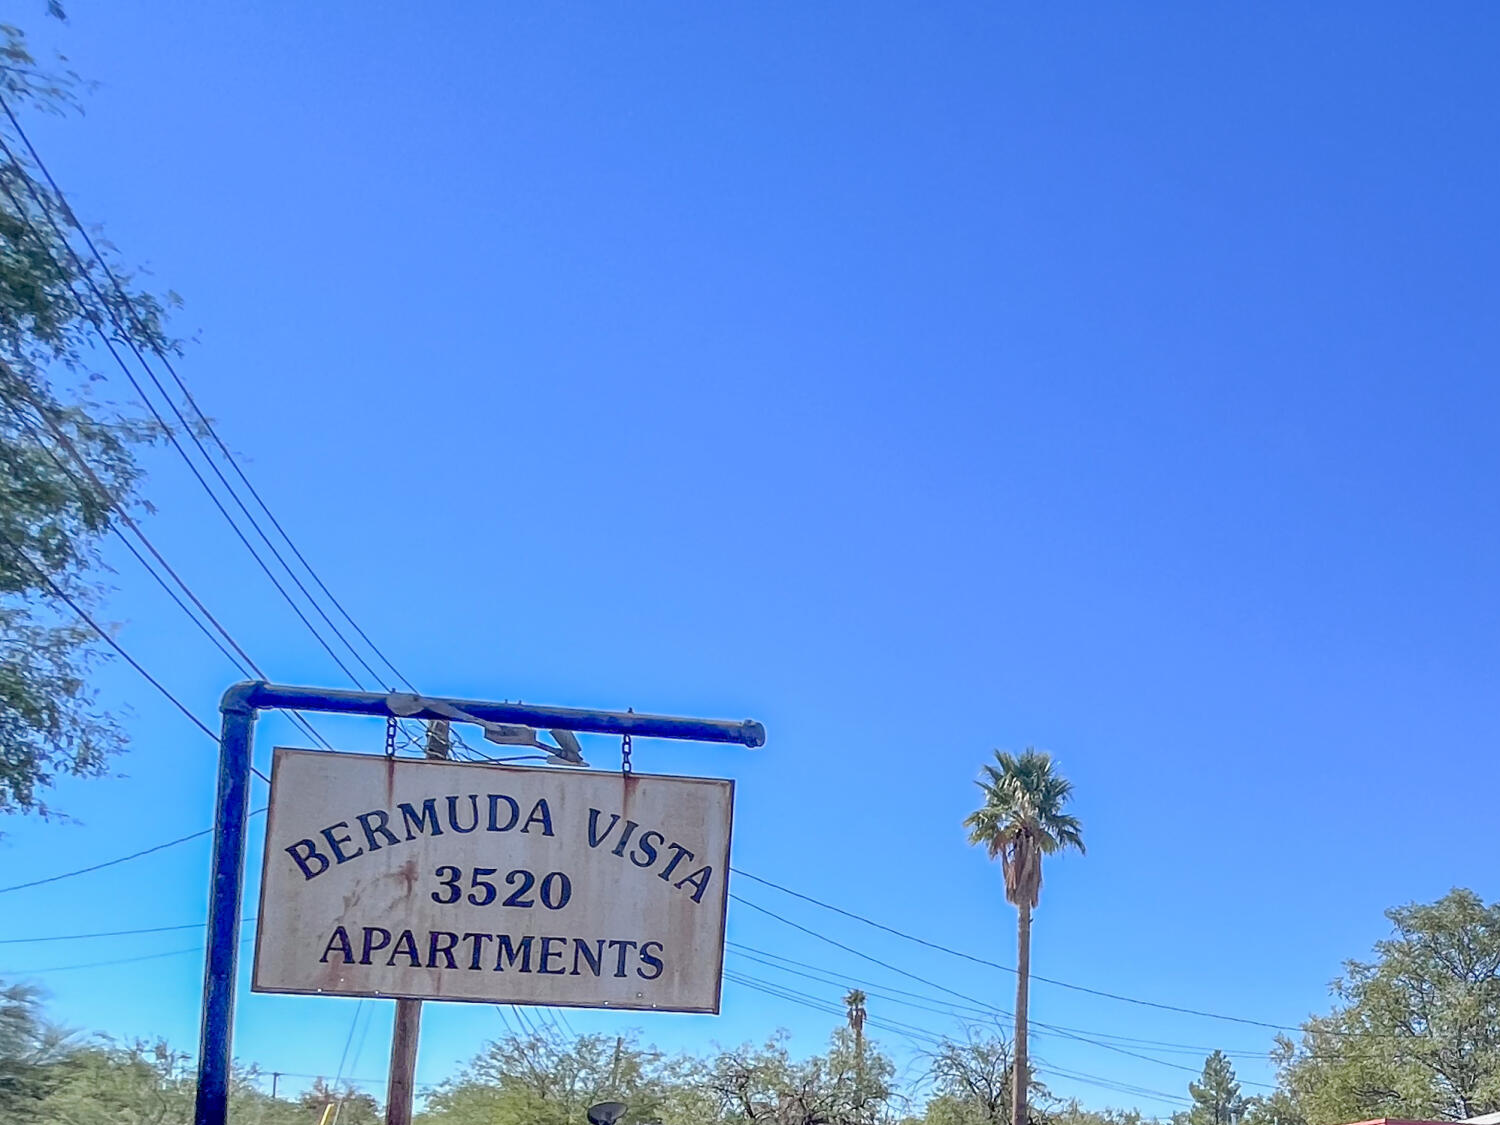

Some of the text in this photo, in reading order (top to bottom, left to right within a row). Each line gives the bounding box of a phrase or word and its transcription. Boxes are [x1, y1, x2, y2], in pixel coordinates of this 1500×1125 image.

[284, 793, 713, 904] BERMUDA VISTA
[430, 865, 572, 910] 3520
[319, 925, 665, 980] APARTMENTS
